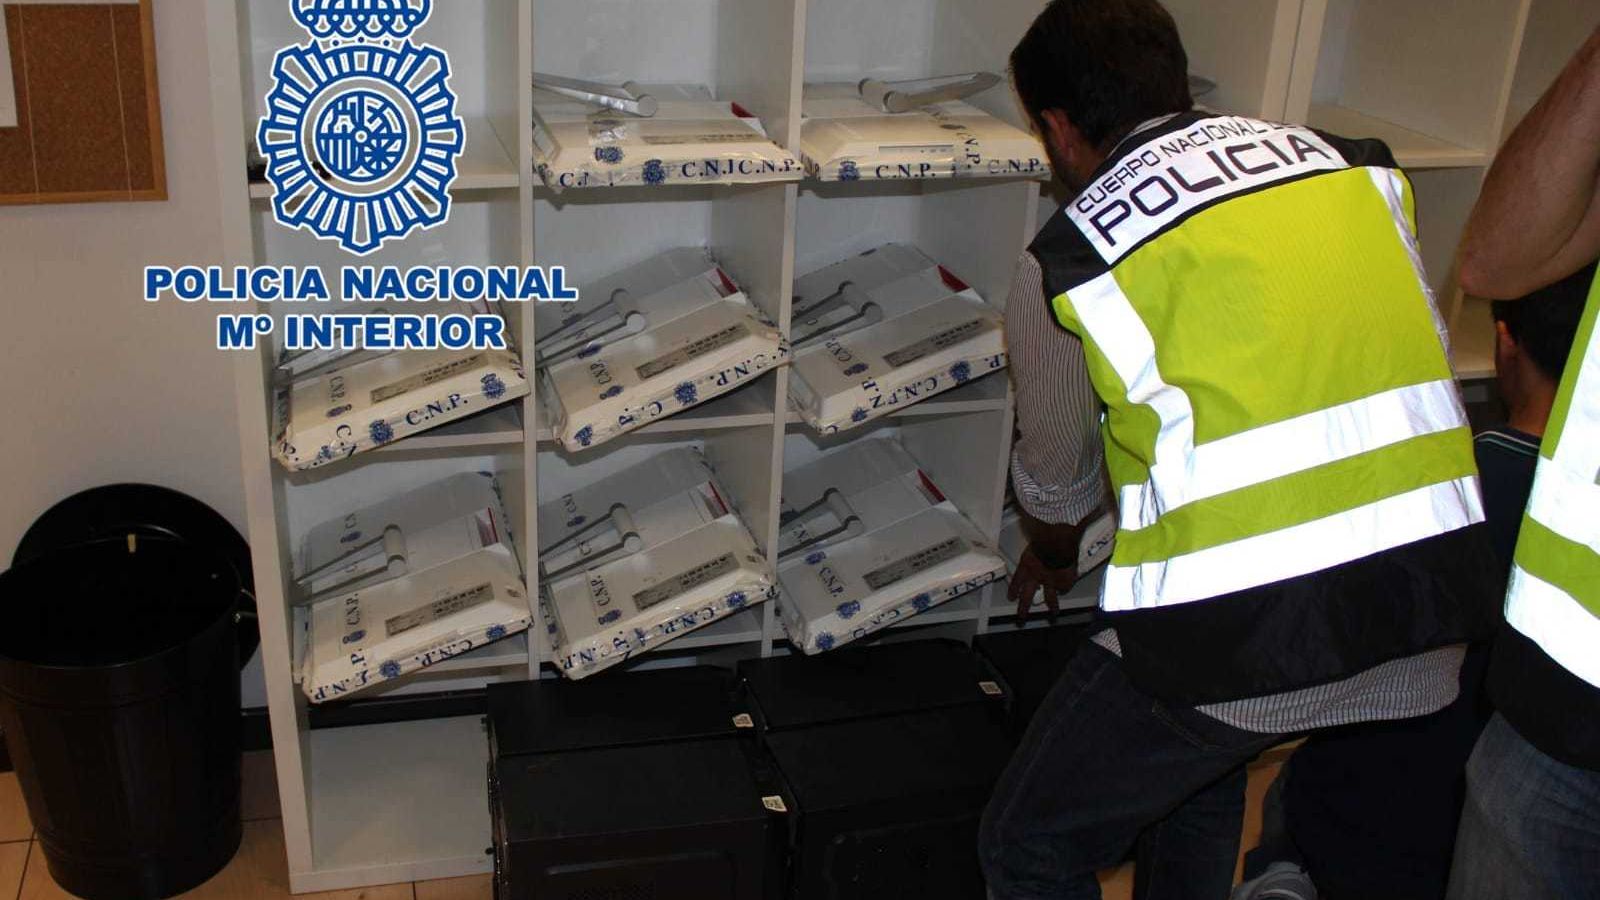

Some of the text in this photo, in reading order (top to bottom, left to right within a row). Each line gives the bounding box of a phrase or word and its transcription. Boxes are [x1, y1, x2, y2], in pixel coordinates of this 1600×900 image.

[876, 163, 936, 181] C.N.P.
[987, 157, 1044, 175] C.N.P.
[1076, 119, 1268, 214] CUERPO NACIONAL
[1088, 133, 1335, 247] POLICIA
[708, 354, 765, 387] C.N.P.
[405, 392, 468, 427] C.N.P.
[658, 606, 715, 635] C.N.P.
[415, 639, 474, 667] C.N.P.
